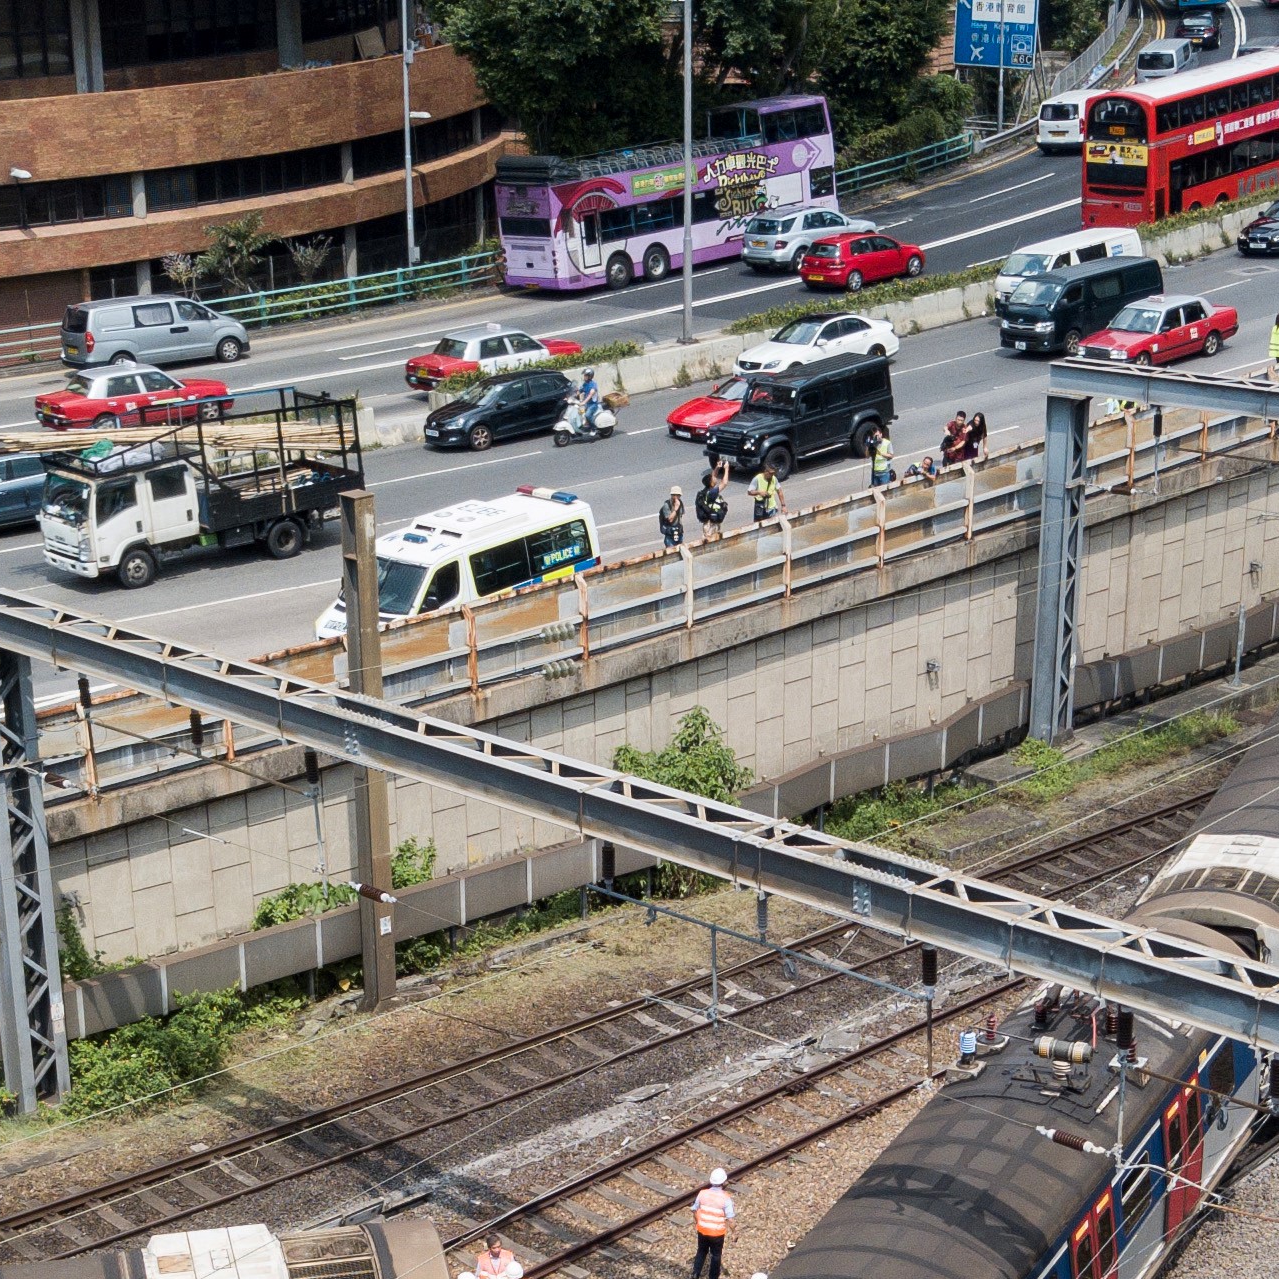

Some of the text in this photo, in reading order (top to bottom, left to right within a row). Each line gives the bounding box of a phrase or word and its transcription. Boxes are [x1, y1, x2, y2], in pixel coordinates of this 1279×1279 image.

[1019, 54, 1033, 64] 6C
[703, 150, 780, 184] 人力車觀光巴士
[550, 550, 574, 563] POLICE
